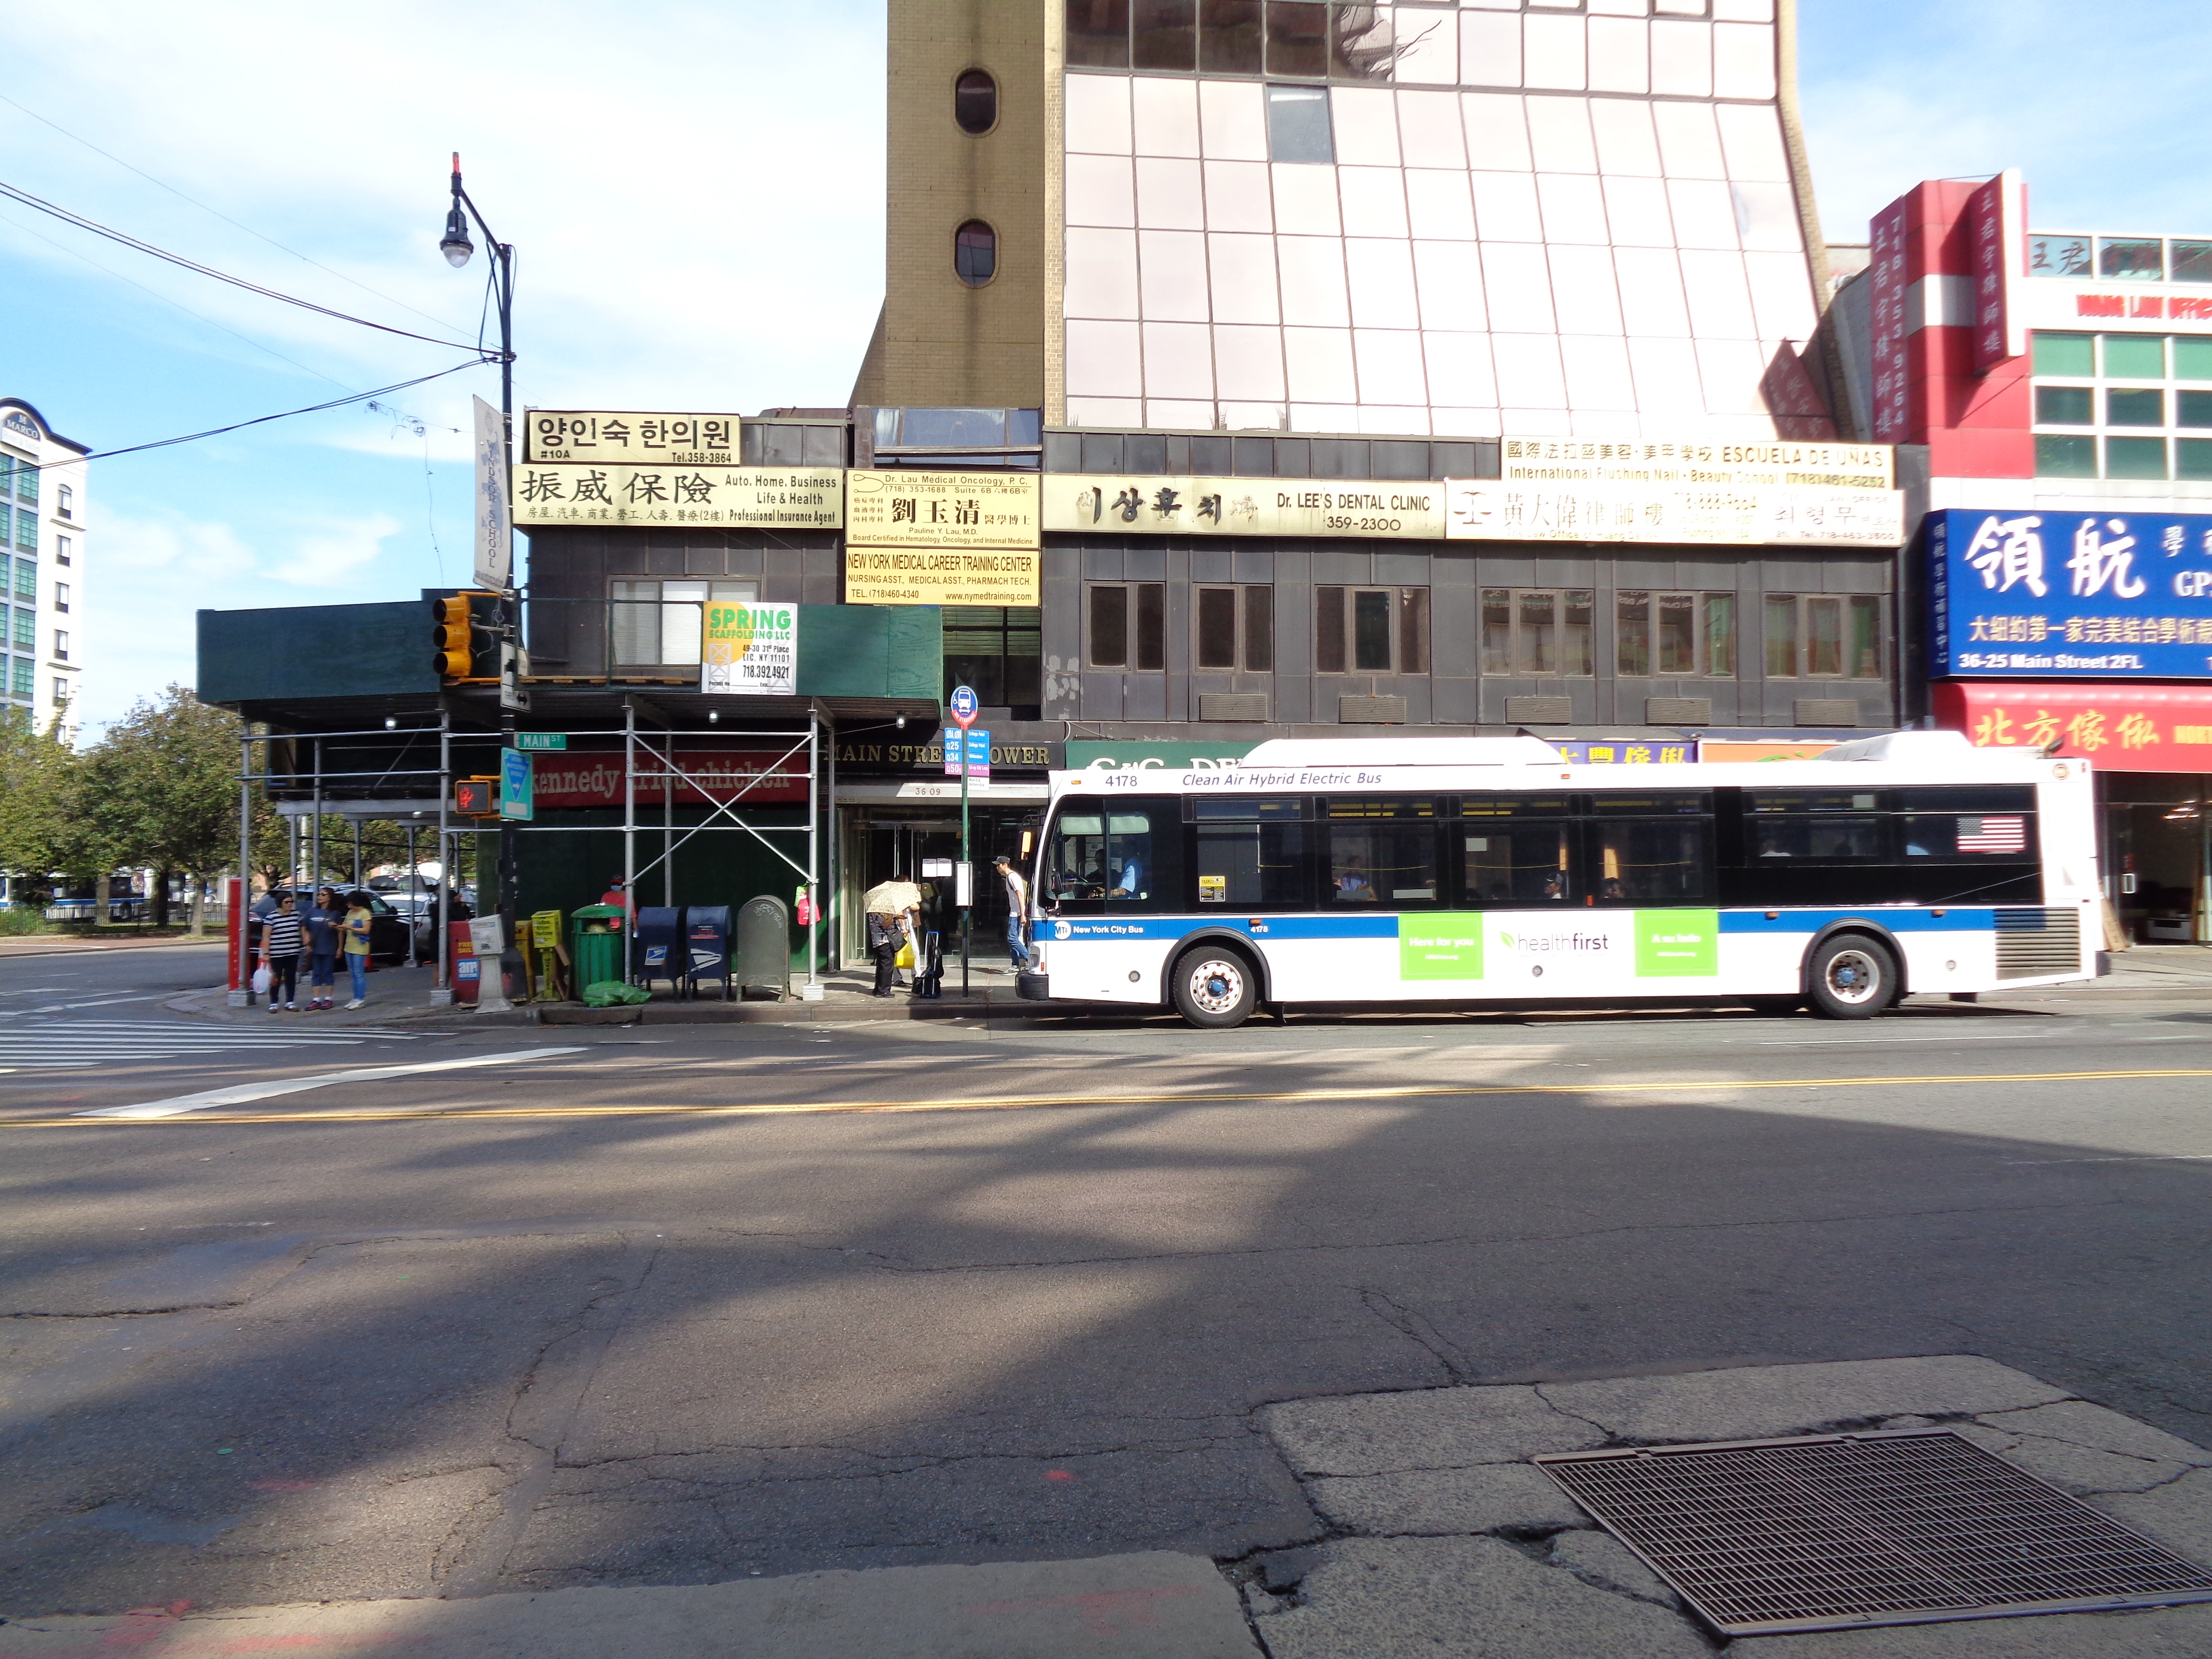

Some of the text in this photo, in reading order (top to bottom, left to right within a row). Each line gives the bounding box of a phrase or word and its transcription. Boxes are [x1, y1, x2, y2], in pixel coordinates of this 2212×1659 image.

[6, 419, 39, 438] MARCO
[538, 417, 730, 450] 양인숙 한의원
[541, 450, 571, 459] #10A
[1723, 445, 1883, 467] ESCUELA DE UÑAS
[725, 474, 836, 488] Auto. Home. Business
[901, 475, 918, 483] Lau
[922, 475, 956, 484] Medical
[960, 476, 1005, 486] Oncology,
[1510, 466, 1778, 484] International Flushing Nail Beauty School
[518, 469, 718, 506] 振威保險
[885, 485, 905, 493] (718)
[757, 492, 823, 505] Life & Health
[1277, 492, 1431, 511] Dr. LEE'S DENTAL CLINIC
[729, 509, 835, 525] Professional Insurance Agent
[891, 498, 981, 525] 劉玉清
[1503, 493, 1663, 529] 黃大偉律師樓
[984, 514, 1030, 525] 醫學博士
[1326, 516, 1401, 532] 359-2300
[905, 535, 940, 544] Hematology,
[942, 536, 971, 544] Oncology,
[1550, 529, 1580, 539] Office
[1583, 531, 1592, 539] of
[848, 553, 1032, 572] NEW YORK MEDICAL CAREER TRAINING CENTER
[1964, 515, 2147, 599] 領航
[848, 574, 881, 583] NURSING
[908, 575, 942, 584] MEDICAL
[967, 577, 1009, 586] PHARMACH
[1010, 577, 1032, 586] TECH.
[851, 589, 919, 599] TEL. (718)460-4340
[945, 591, 1032, 602] www.nymedtraining.com
[709, 608, 791, 630] SPRING
[709, 629, 790, 640] SCAFFOLDING LLC
[742, 644, 760, 653] 49-30
[759, 654, 790, 662] NY 11101
[1958, 653, 2144, 669] 36-25 Main Street 2FL
[743, 665, 789, 679] 718.392.4921
[954, 711, 976, 723] NO STANDING
[1975, 707, 2160, 752] 北方傢俬
[523, 735, 550, 747] MAIN
[946, 741, 959, 750] Q25
[823, 744, 1050, 765] MAIN OWER
[946, 753, 959, 762] Q34
[946, 764, 959, 773] Q50
[692, 761, 789, 789] chicken
[1105, 775, 1137, 787] 4178
[1182, 772, 1382, 788] Clean Air Hybrid Electric Bus
[915, 787, 941, 796] 36 09
[1055, 924, 1143, 936] MTA New York City Bus
[1409, 936, 1474, 948] Here for you
[1518, 932, 1609, 951] healthfirst
[1652, 933, 1702, 944] A su lado
